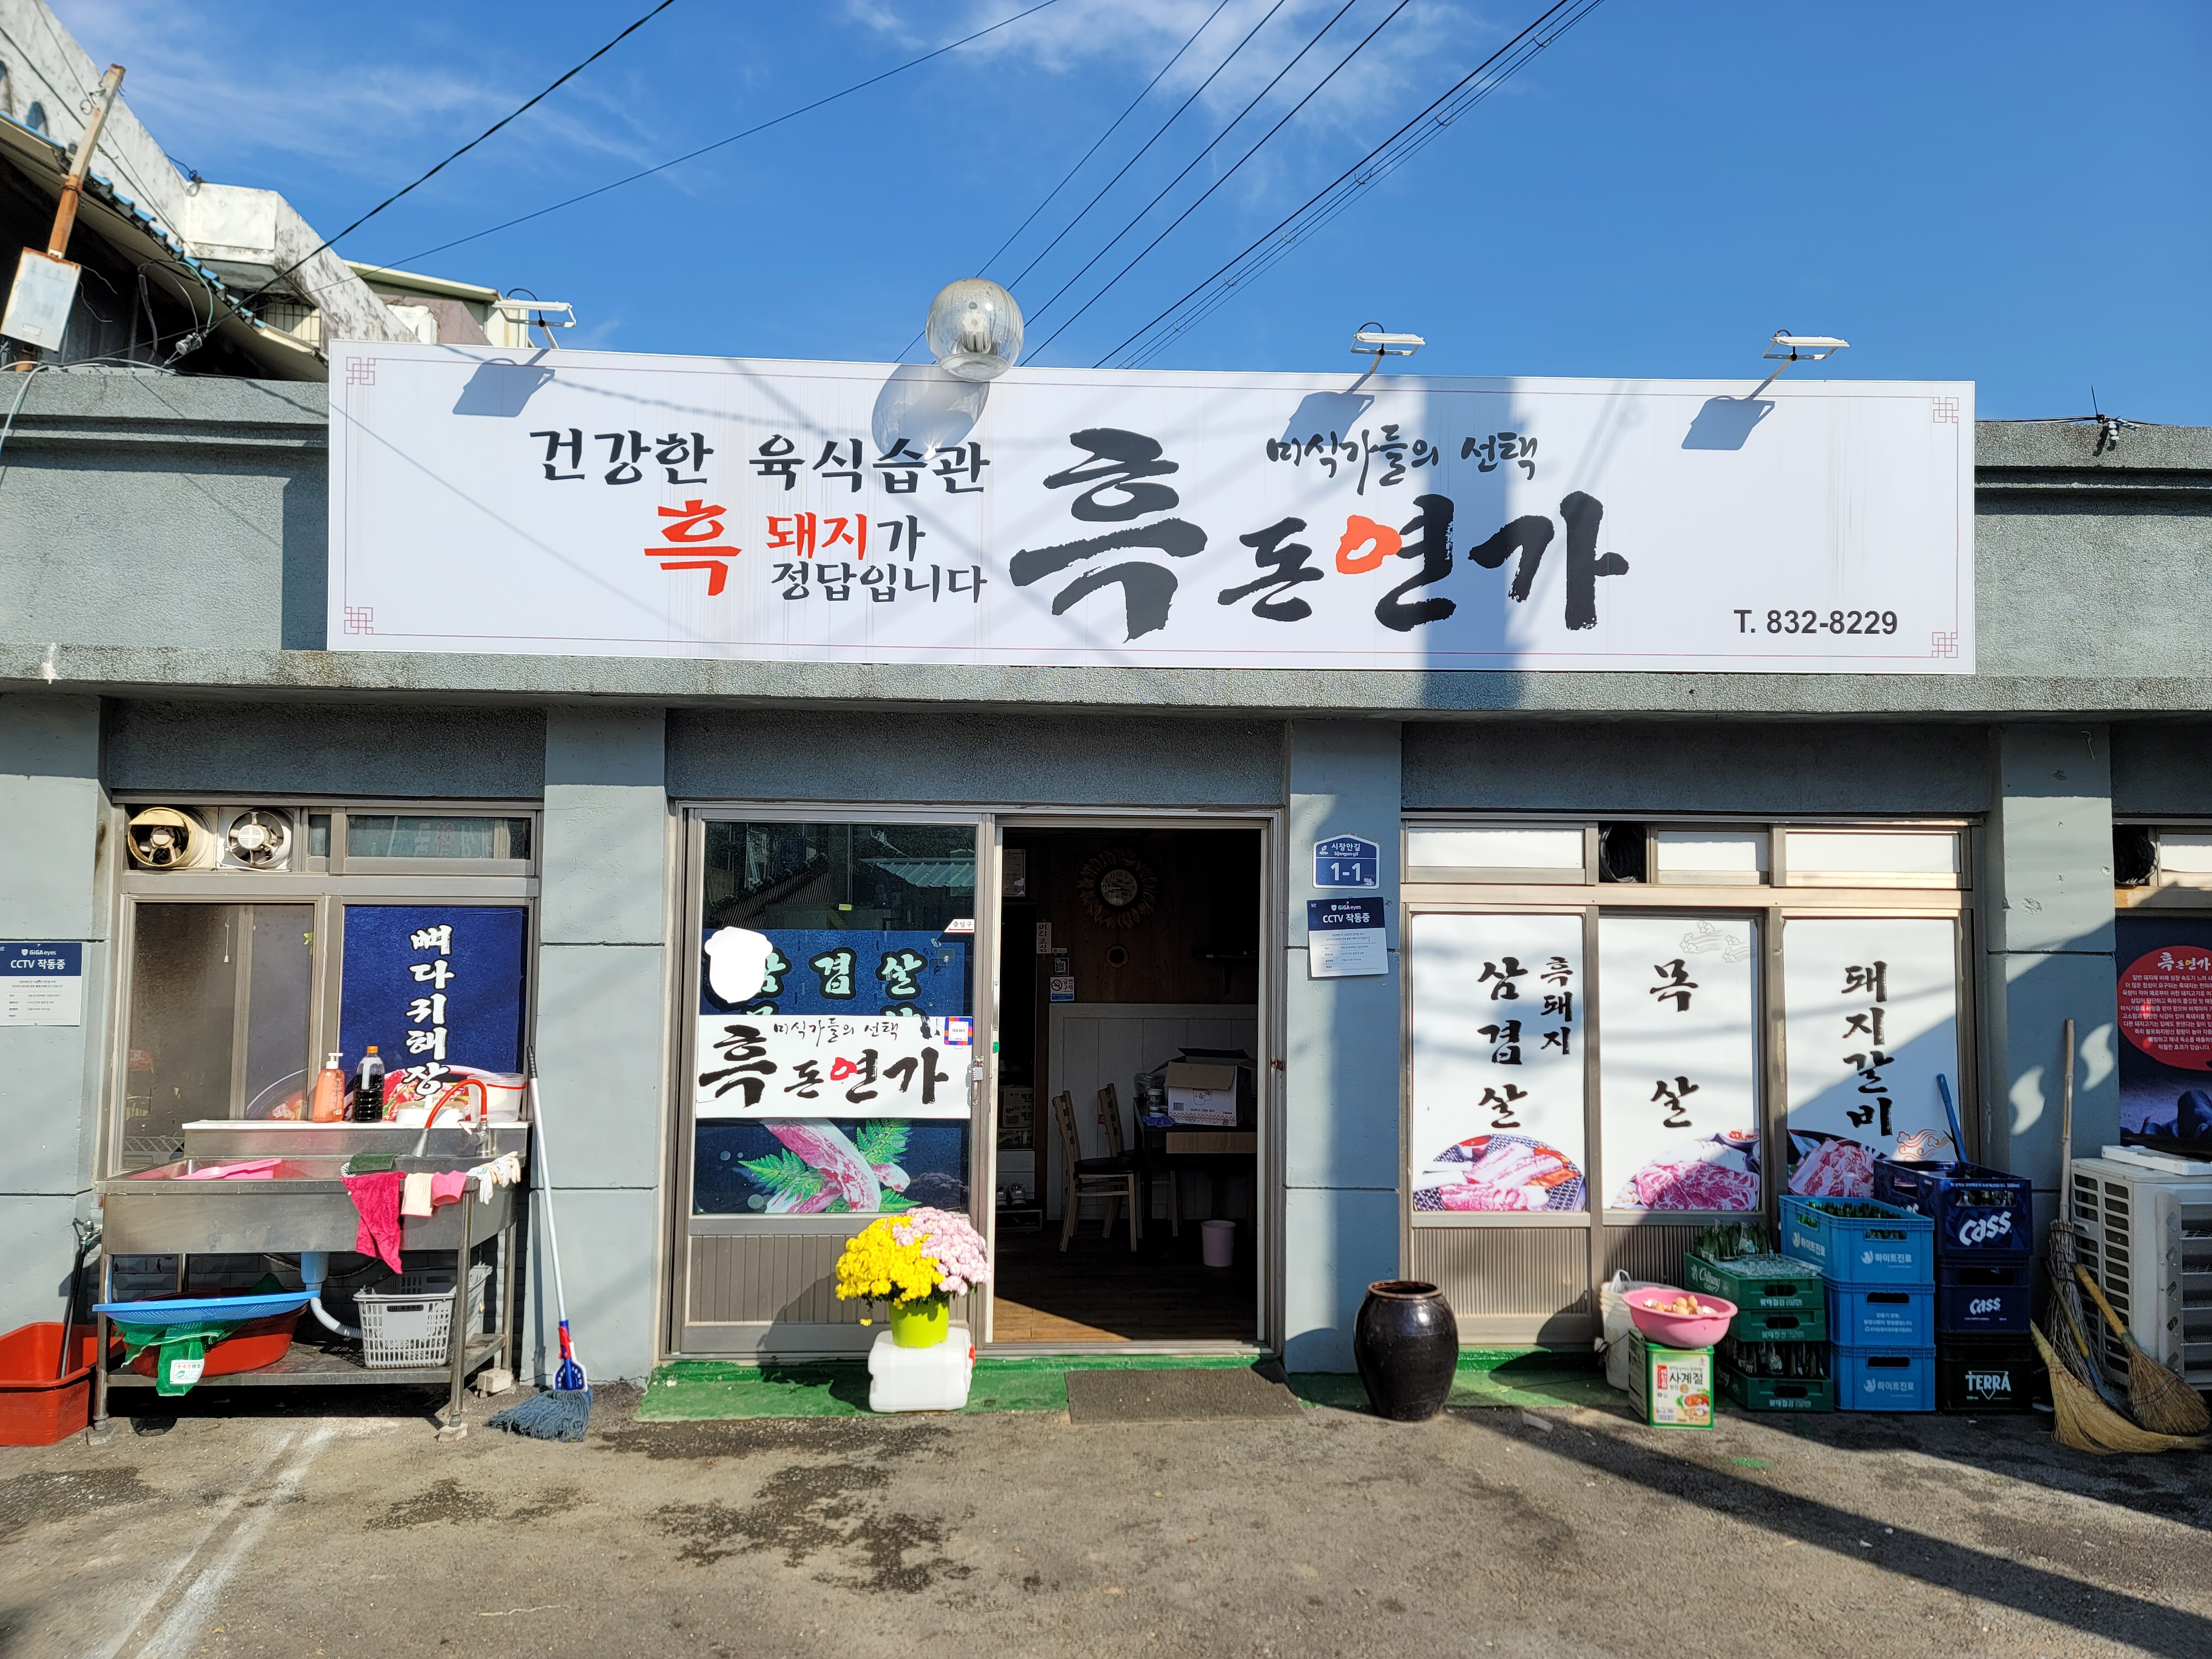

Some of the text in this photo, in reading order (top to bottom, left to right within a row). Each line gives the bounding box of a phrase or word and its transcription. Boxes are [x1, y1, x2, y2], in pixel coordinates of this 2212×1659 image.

[530, 427, 990, 494] 건강한 육식습관
[1266, 424, 1538, 495] 미식가들의 선택
[644, 499, 926, 596] 흑 돼지가
[1009, 427, 1630, 643] 흑돈연가
[771, 561, 988, 603] 정답입니다
[1734, 609, 1897, 634] T. 832-8229
[1331, 843, 1360, 852] 시장안길
[1331, 862, 1360, 881] 1-1
[1323, 912, 1370, 923] CCTV 작동중
[1039, 923, 1047, 953] 머리조심
[11, 959, 66, 969] CCTV 작동중
[2157, 952, 2211, 972] 흑돈연가
[404, 925, 454, 1097] 뼈다귀해장
[1540, 956, 1574, 1055] 흑돼지
[773, 1018, 899, 1047] 미식가들의 선택
[1478, 956, 1528, 1128] 삼겹살
[1650, 958, 1699, 1128] 목살
[1841, 960, 1895, 1136] 돼지갈비
[698, 1024, 950, 1109] 흑돈연가
[1801, 1237, 1825, 1257] 하이트진로
[1875, 1253, 1912, 1264] 하이트진로
[1670, 1372, 1703, 1385] 사계절
[1965, 1374, 2011, 1391] TERRA
